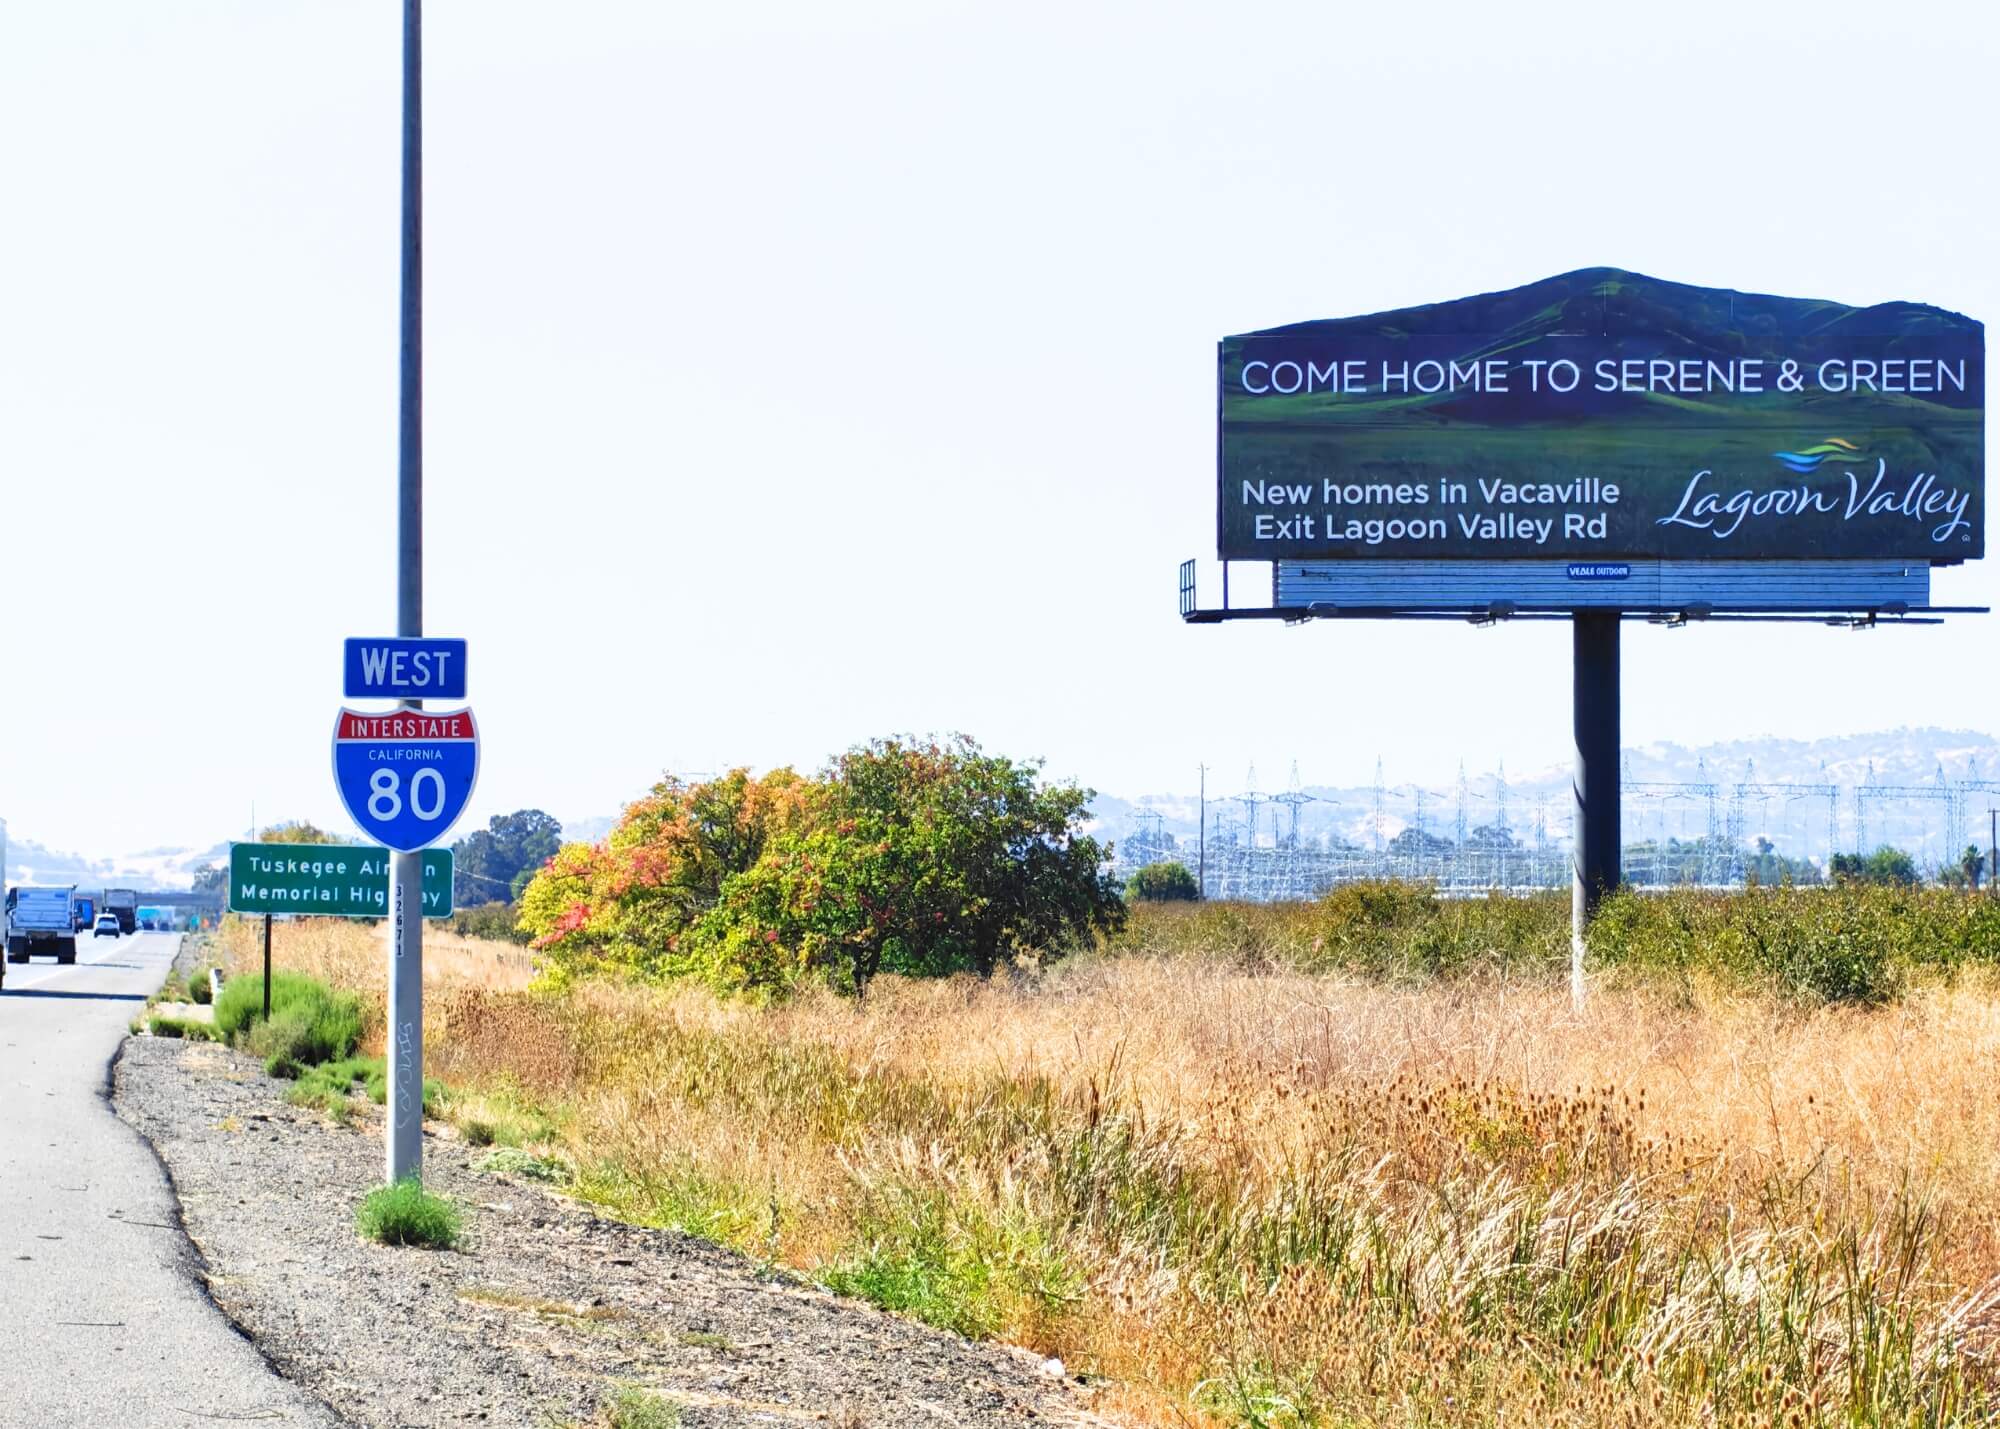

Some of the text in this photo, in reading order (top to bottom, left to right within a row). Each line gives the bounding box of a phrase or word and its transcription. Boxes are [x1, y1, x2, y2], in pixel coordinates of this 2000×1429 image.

[1241, 359, 1965, 394] COME HOME TO SERENE & GREEN
[1242, 478, 1621, 505] New homes in Vacaville
[1655, 457, 1971, 542] Lagoon Valley
[1255, 513, 1607, 545] Exit Lagoon Valley Rd
[361, 647, 451, 687] WEST
[351, 719, 461, 738] INTERSTATE
[368, 749, 444, 761] CALIFORNIA
[367, 767, 446, 822] 80
[249, 857, 436, 878] Tuskegee Airn
[241, 884, 338, 901] Memorial
